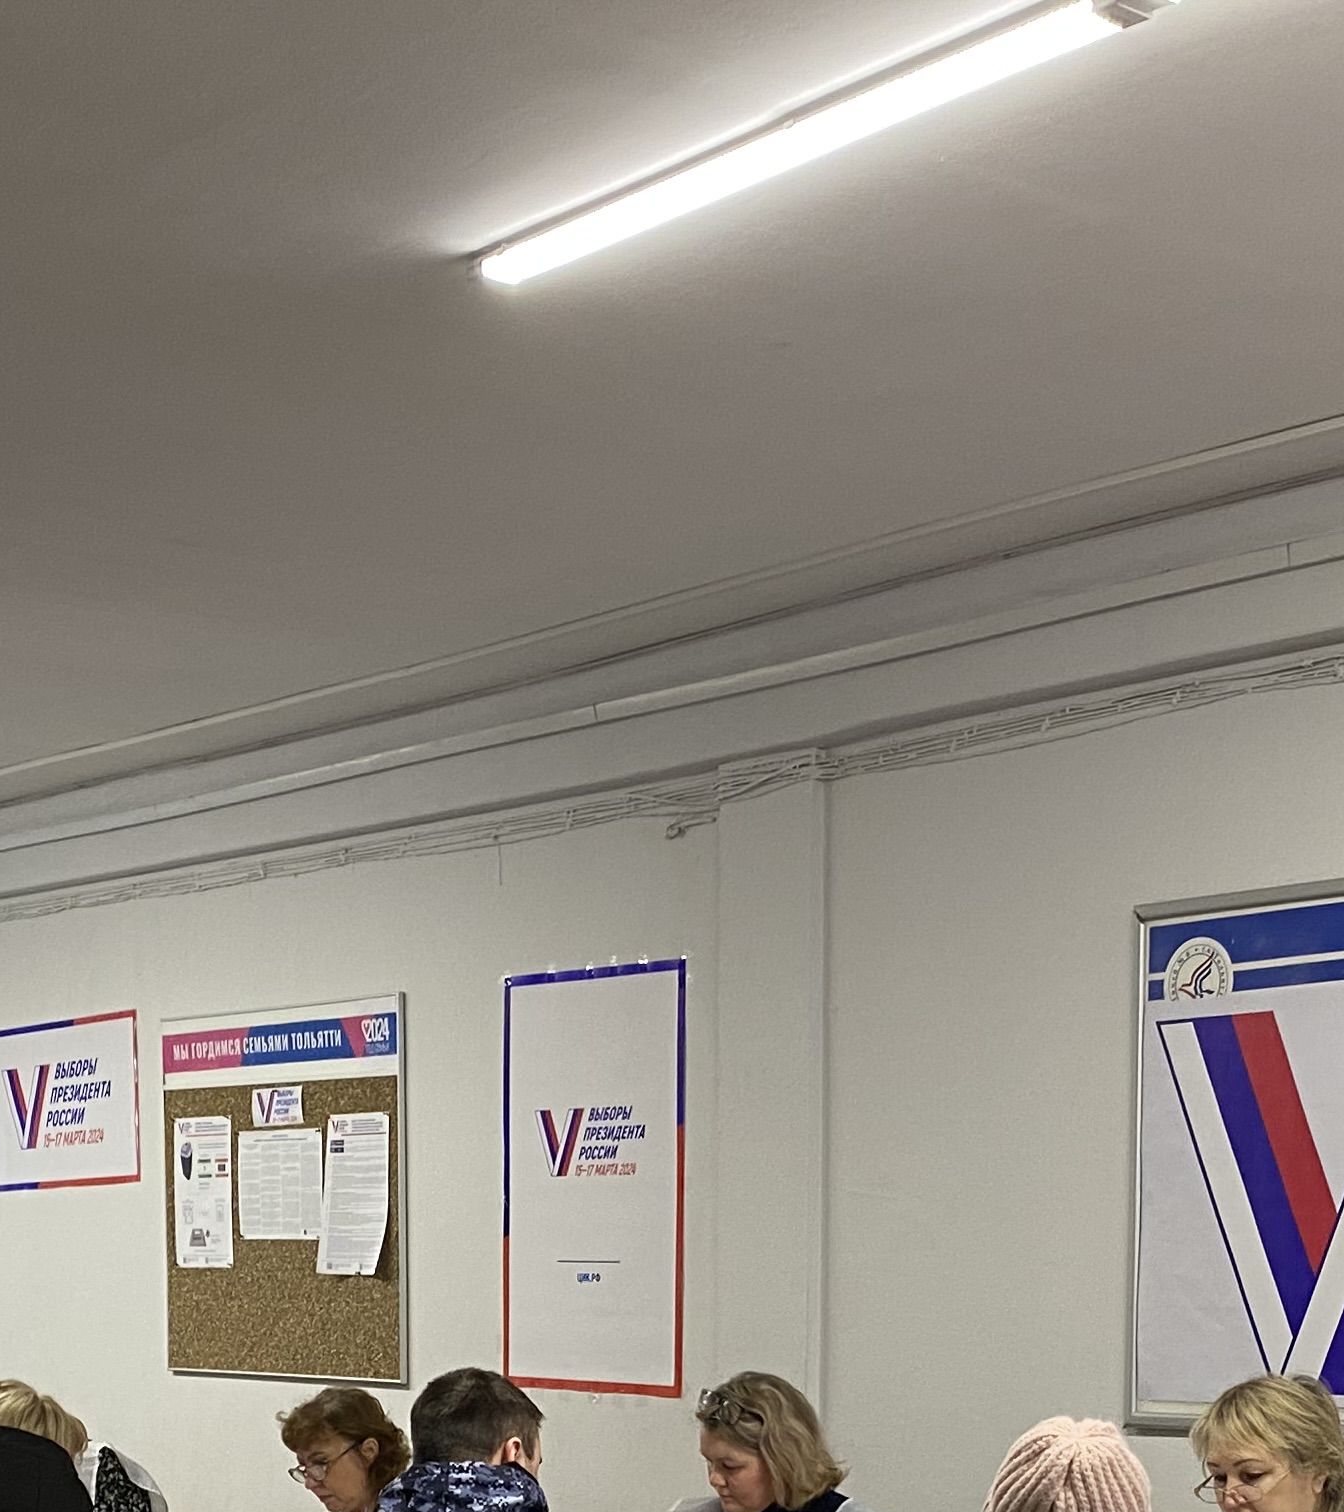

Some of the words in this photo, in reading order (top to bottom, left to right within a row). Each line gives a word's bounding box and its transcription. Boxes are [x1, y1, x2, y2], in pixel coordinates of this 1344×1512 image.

[173, 1044, 188, 1061] МЫ
[191, 1038, 241, 1060] ГОРДИМСЯ
[243, 1036, 288, 1054] СЕМЬЯМИ
[291, 1029, 342, 1050] ТОЛЬЯТТИ
[54, 1057, 98, 1080] ВЫБОРЫ
[50, 1080, 111, 1104] ПРЕЗИДЕНТА
[46, 1107, 86, 1128] РОССИИ
[588, 1105, 633, 1122] ВЫБОРЫ
[62, 1130, 86, 1146] МАРТА
[87, 1128, 104, 1144] 2024
[583, 1124, 646, 1142] ПРЕЗИДЕНТА
[579, 1145, 619, 1161] РОССИИ
[595, 1163, 618, 1176] МАРТА
[618, 1162, 637, 1175] 2024
